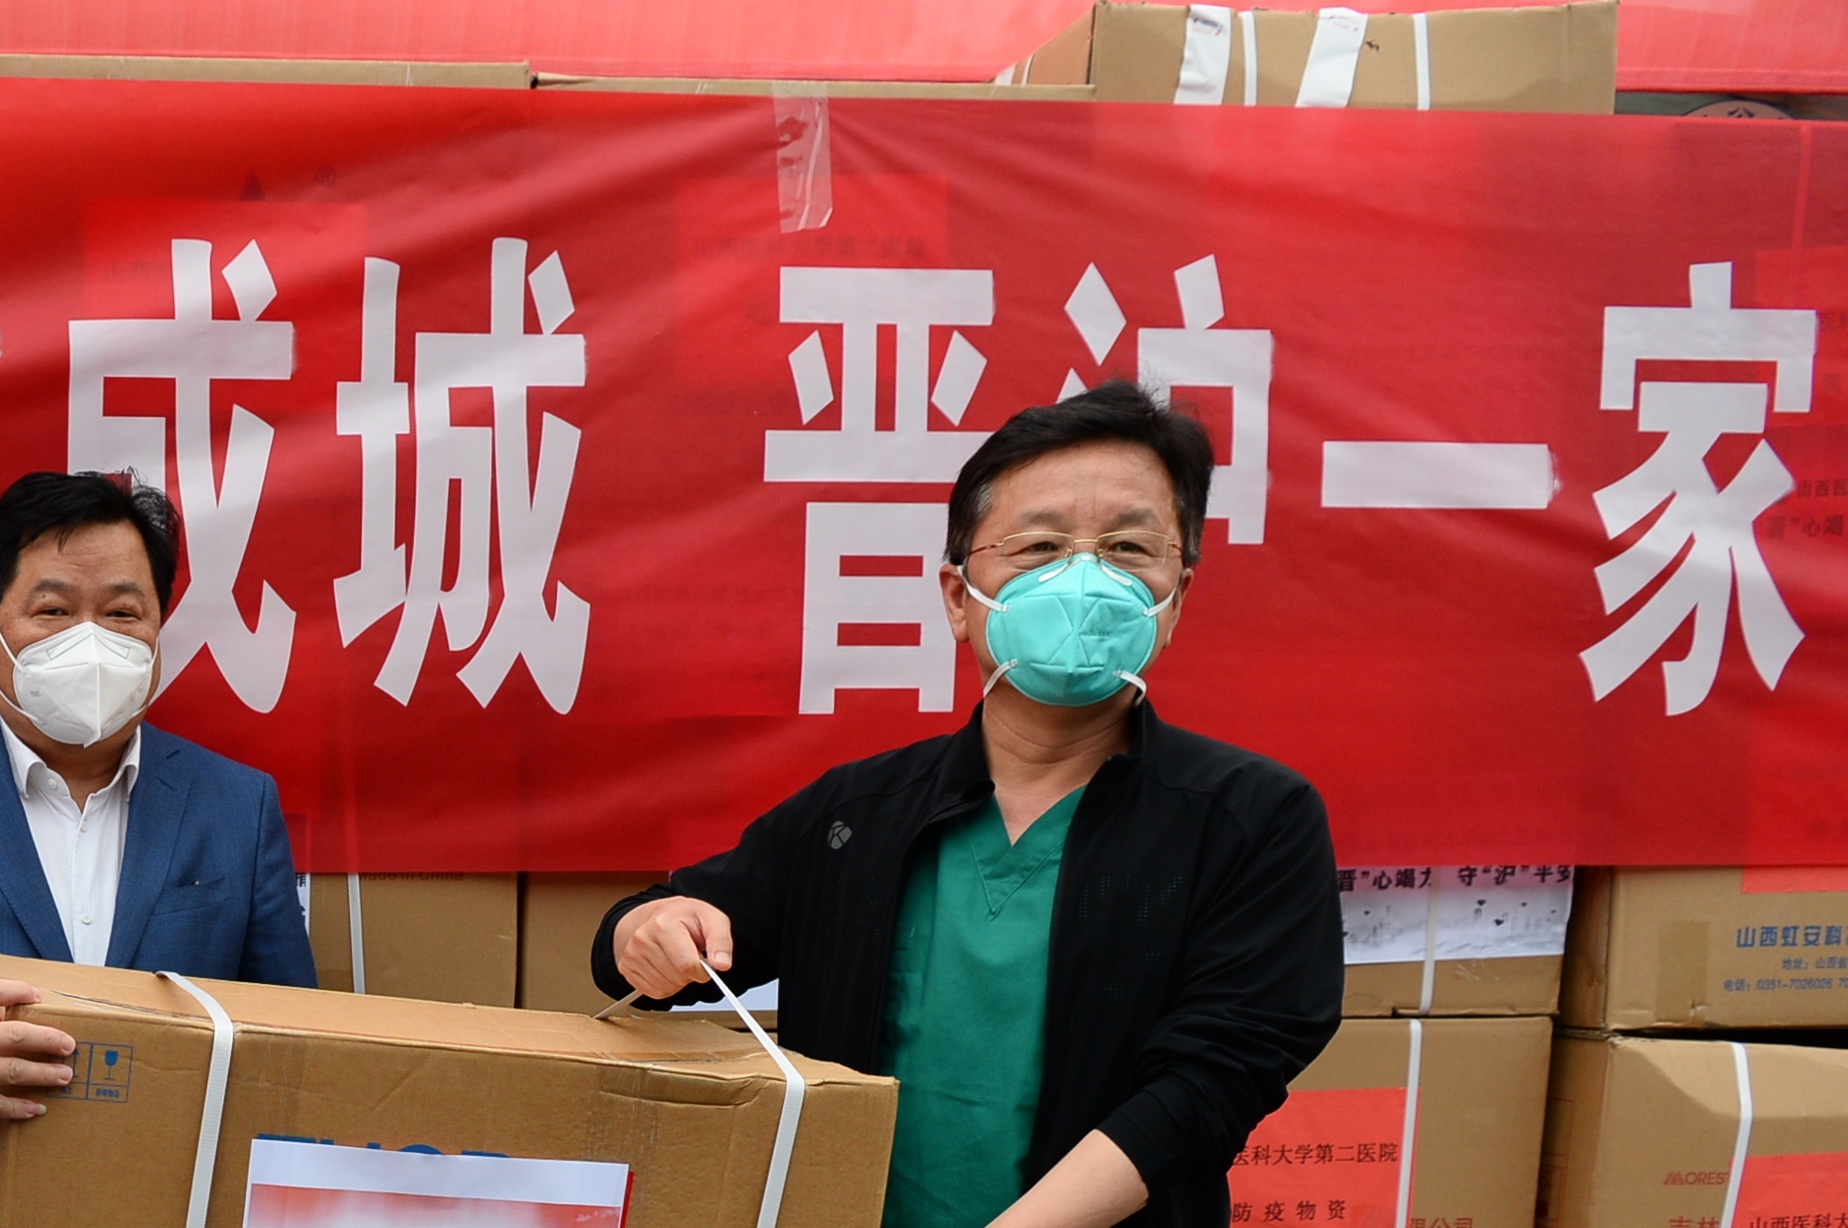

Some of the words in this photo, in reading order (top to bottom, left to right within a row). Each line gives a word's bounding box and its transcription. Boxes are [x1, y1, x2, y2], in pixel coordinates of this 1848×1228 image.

[1736, 925, 1848, 948] 山西虹安科
[1231, 1199, 1347, 1224] 防疫物资
